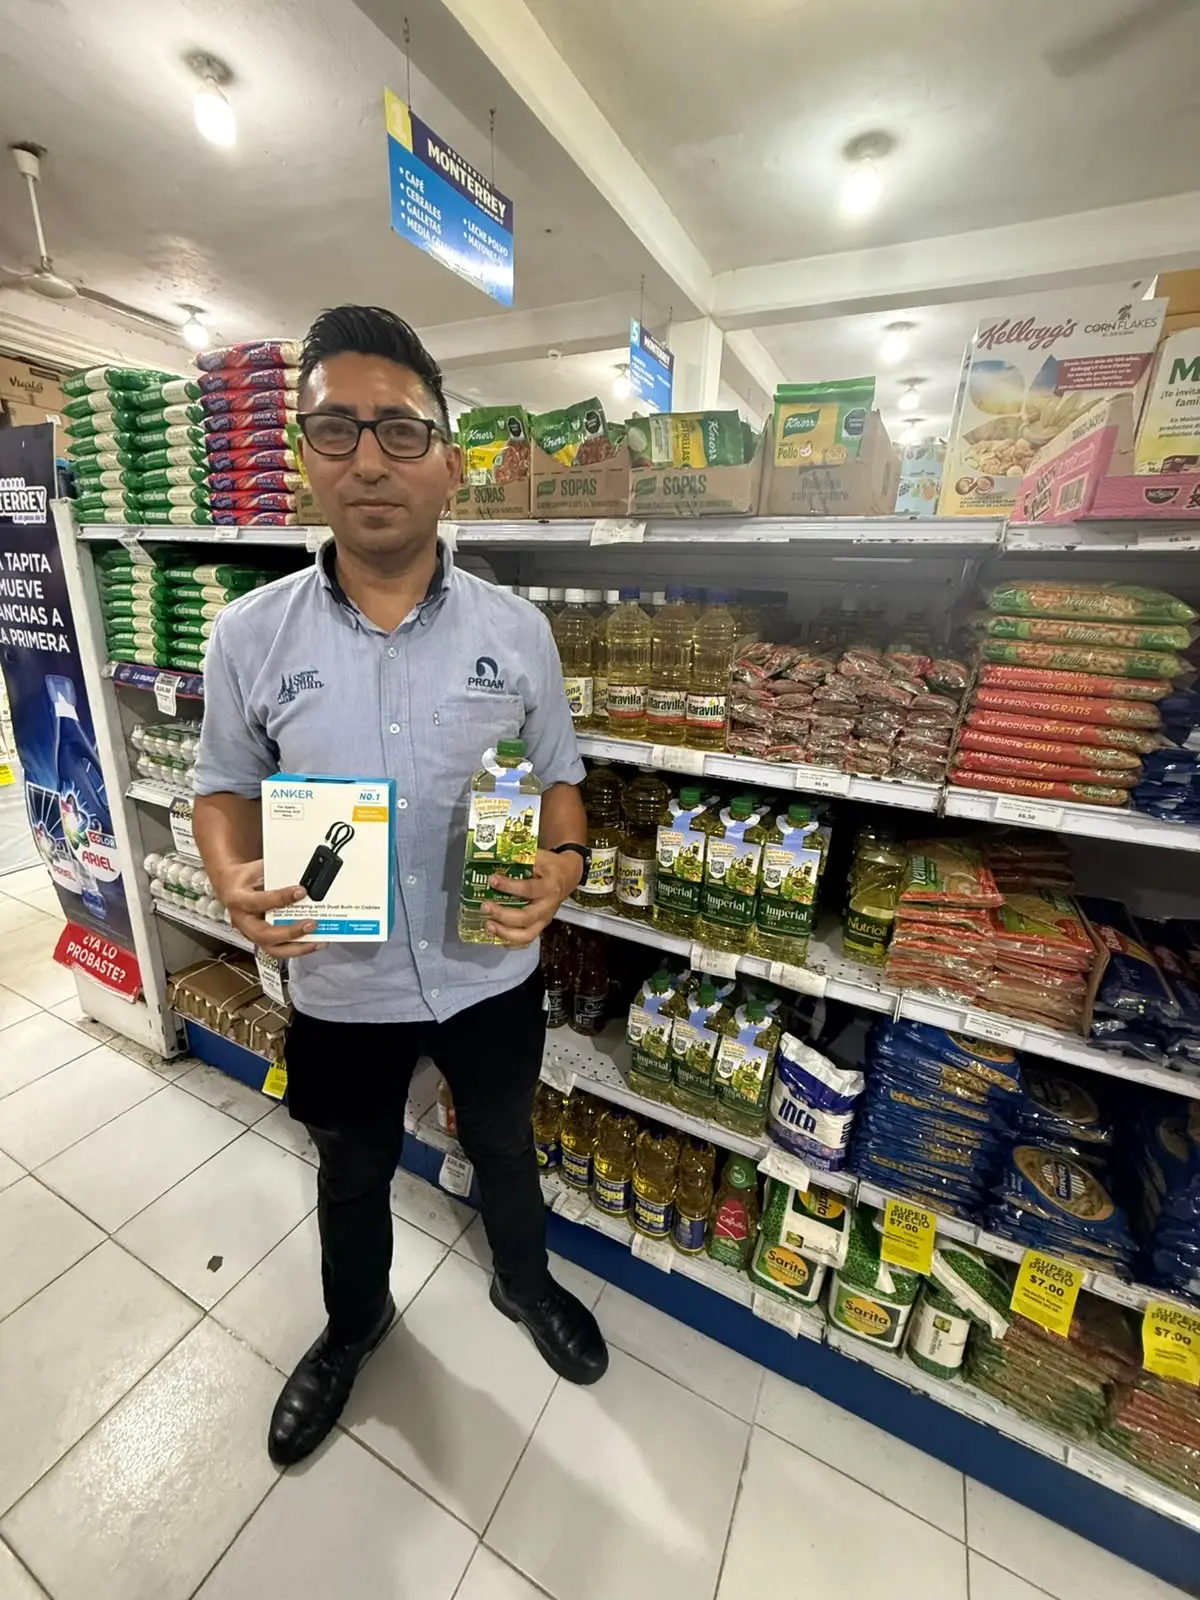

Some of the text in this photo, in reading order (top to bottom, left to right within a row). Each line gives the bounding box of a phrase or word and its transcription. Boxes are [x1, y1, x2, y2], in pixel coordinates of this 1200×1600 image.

[391, 102, 407, 141] 1
[405, 171, 424, 192] CAFÉ
[427, 138, 506, 218] MONTERREY
[406, 186, 442, 220] CEREALES
[407, 202, 442, 234] GALLETAS
[977, 317, 1079, 350] Kellogg's
[1084, 318, 1157, 334] CORN FLAKES
[1176, 397, 1200, 407] fami
[785, 417, 815, 429] Knorr
[466, 429, 494, 442] Knorr
[708, 420, 720, 463] Knorr
[777, 448, 799, 460] Pollo
[560, 479, 597, 496] SOPAS
[0, 489, 45, 512] TERREY
[4, 552, 52, 573] TAPITA
[0, 578, 44, 600] MUEVE
[0, 603, 64, 627] ANCHAS A
[9, 628, 70, 653] PRIMERA
[468, 677, 504, 689] PROAN
[1007, 680, 1054, 689] PRODUCTO
[1055, 682, 1095, 693] GRATIS
[1004, 699, 1050, 710] PRODUCTO
[1051, 703, 1092, 715] GRATIS
[996, 721, 1041, 731] PRODUCTO
[1043, 724, 1081, 736] GRATIS
[979, 734, 1023, 748] PRODUCTO
[1024, 742, 1062, 753] GRATIS
[973, 773, 1017, 785] PRODUCTO
[1017, 780, 1055, 790] GRATIS
[270, 789, 314, 799] ANKER
[359, 793, 380, 801] NO.1
[89, 831, 116, 848] COLOR
[82, 850, 115, 873] ARIEL
[657, 881, 693, 899] Imperial
[707, 894, 745, 912] Imperial
[766, 904, 808, 922] Imperial
[83, 935, 117, 959] ¿YA LO
[67, 941, 126, 983] PROBASTE?
[637, 1052, 668, 1071] Imperial
[677, 1067, 710, 1086] Imperial
[890, 1210, 930, 1229] PRECIO
[894, 1205, 928, 1221] SUPER
[889, 1218, 919, 1234] $7.00
[767, 1250, 807, 1278] Sarita
[1034, 1257, 1074, 1279] SUPER
[1029, 1262, 1074, 1288] PRECIO
[1029, 1274, 1065, 1297] $7.00
[844, 1299, 889, 1326] Sarita
[1154, 1326, 1192, 1345] $7.00
